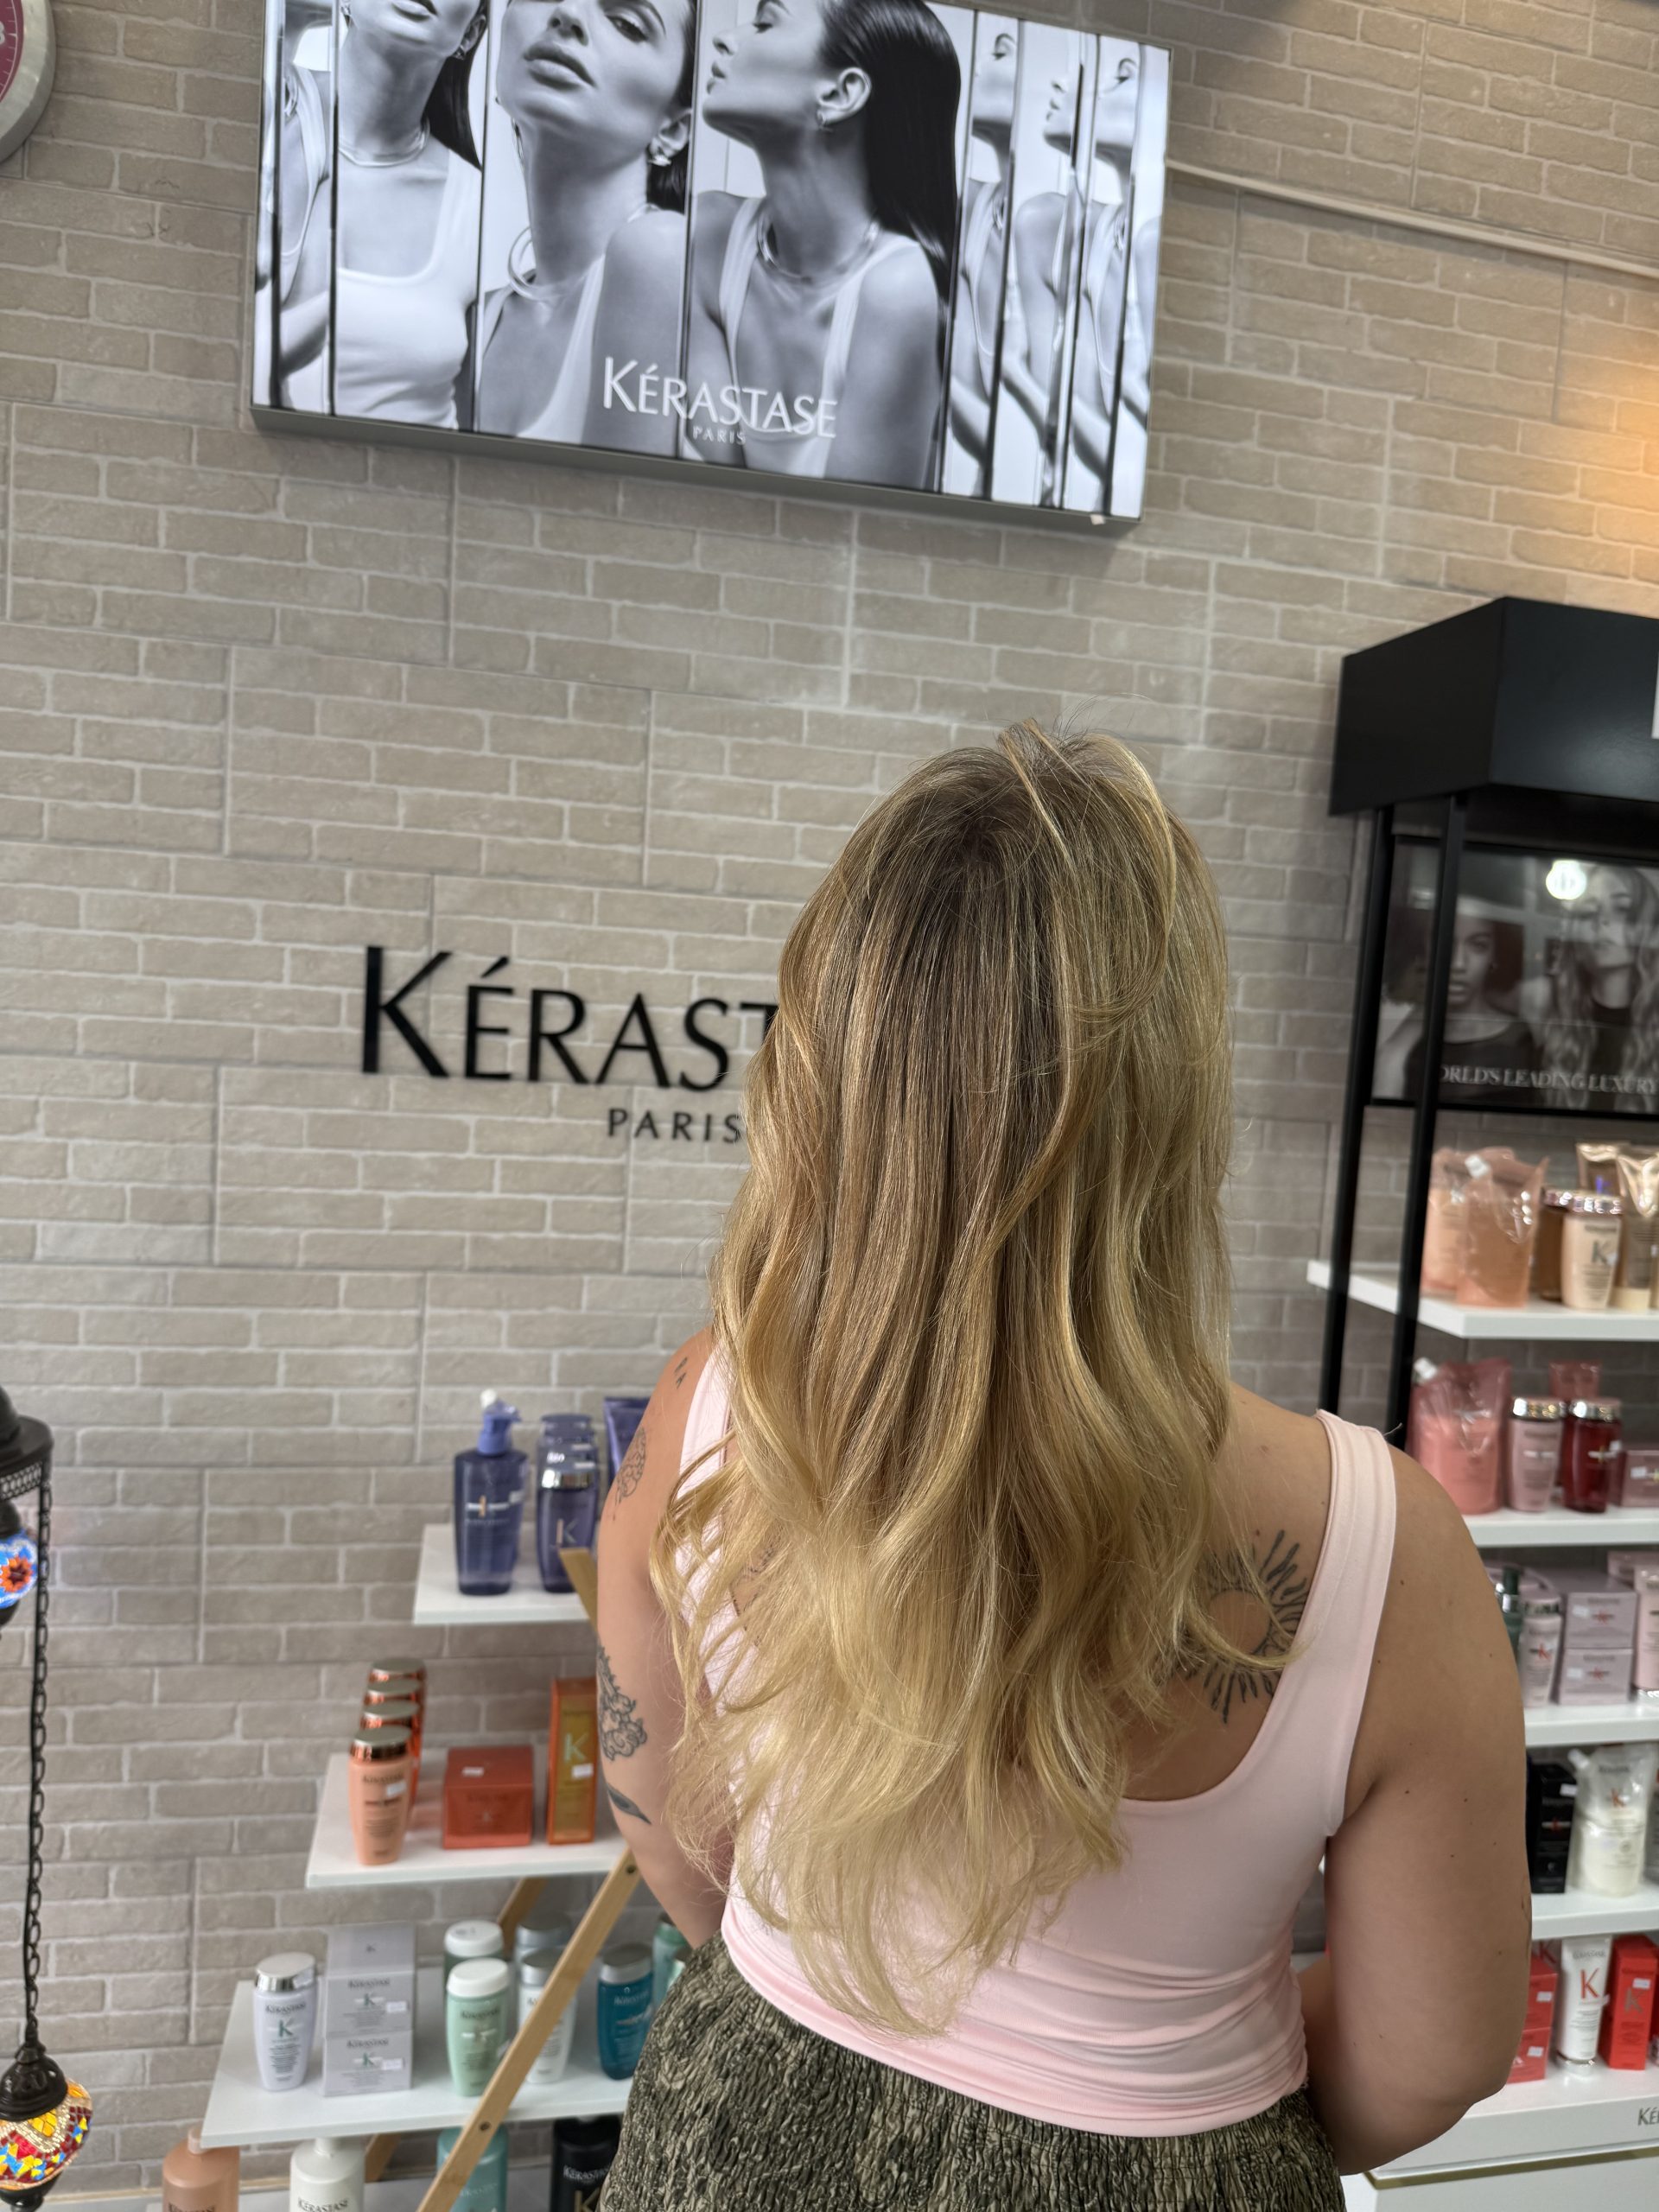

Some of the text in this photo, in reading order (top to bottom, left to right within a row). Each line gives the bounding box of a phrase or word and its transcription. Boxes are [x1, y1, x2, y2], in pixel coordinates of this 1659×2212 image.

[603, 355, 838, 439] KÉRASTASE
[692, 425, 747, 446] PARIS
[1503, 1068, 1585, 1089] LEADING
[1588, 1074, 1658, 1096] LUXURY
[608, 1108, 742, 1144] PARIS
[564, 1732, 590, 1762] K
[1580, 1967, 1600, 1999] K
[278, 2018, 296, 2038] K
